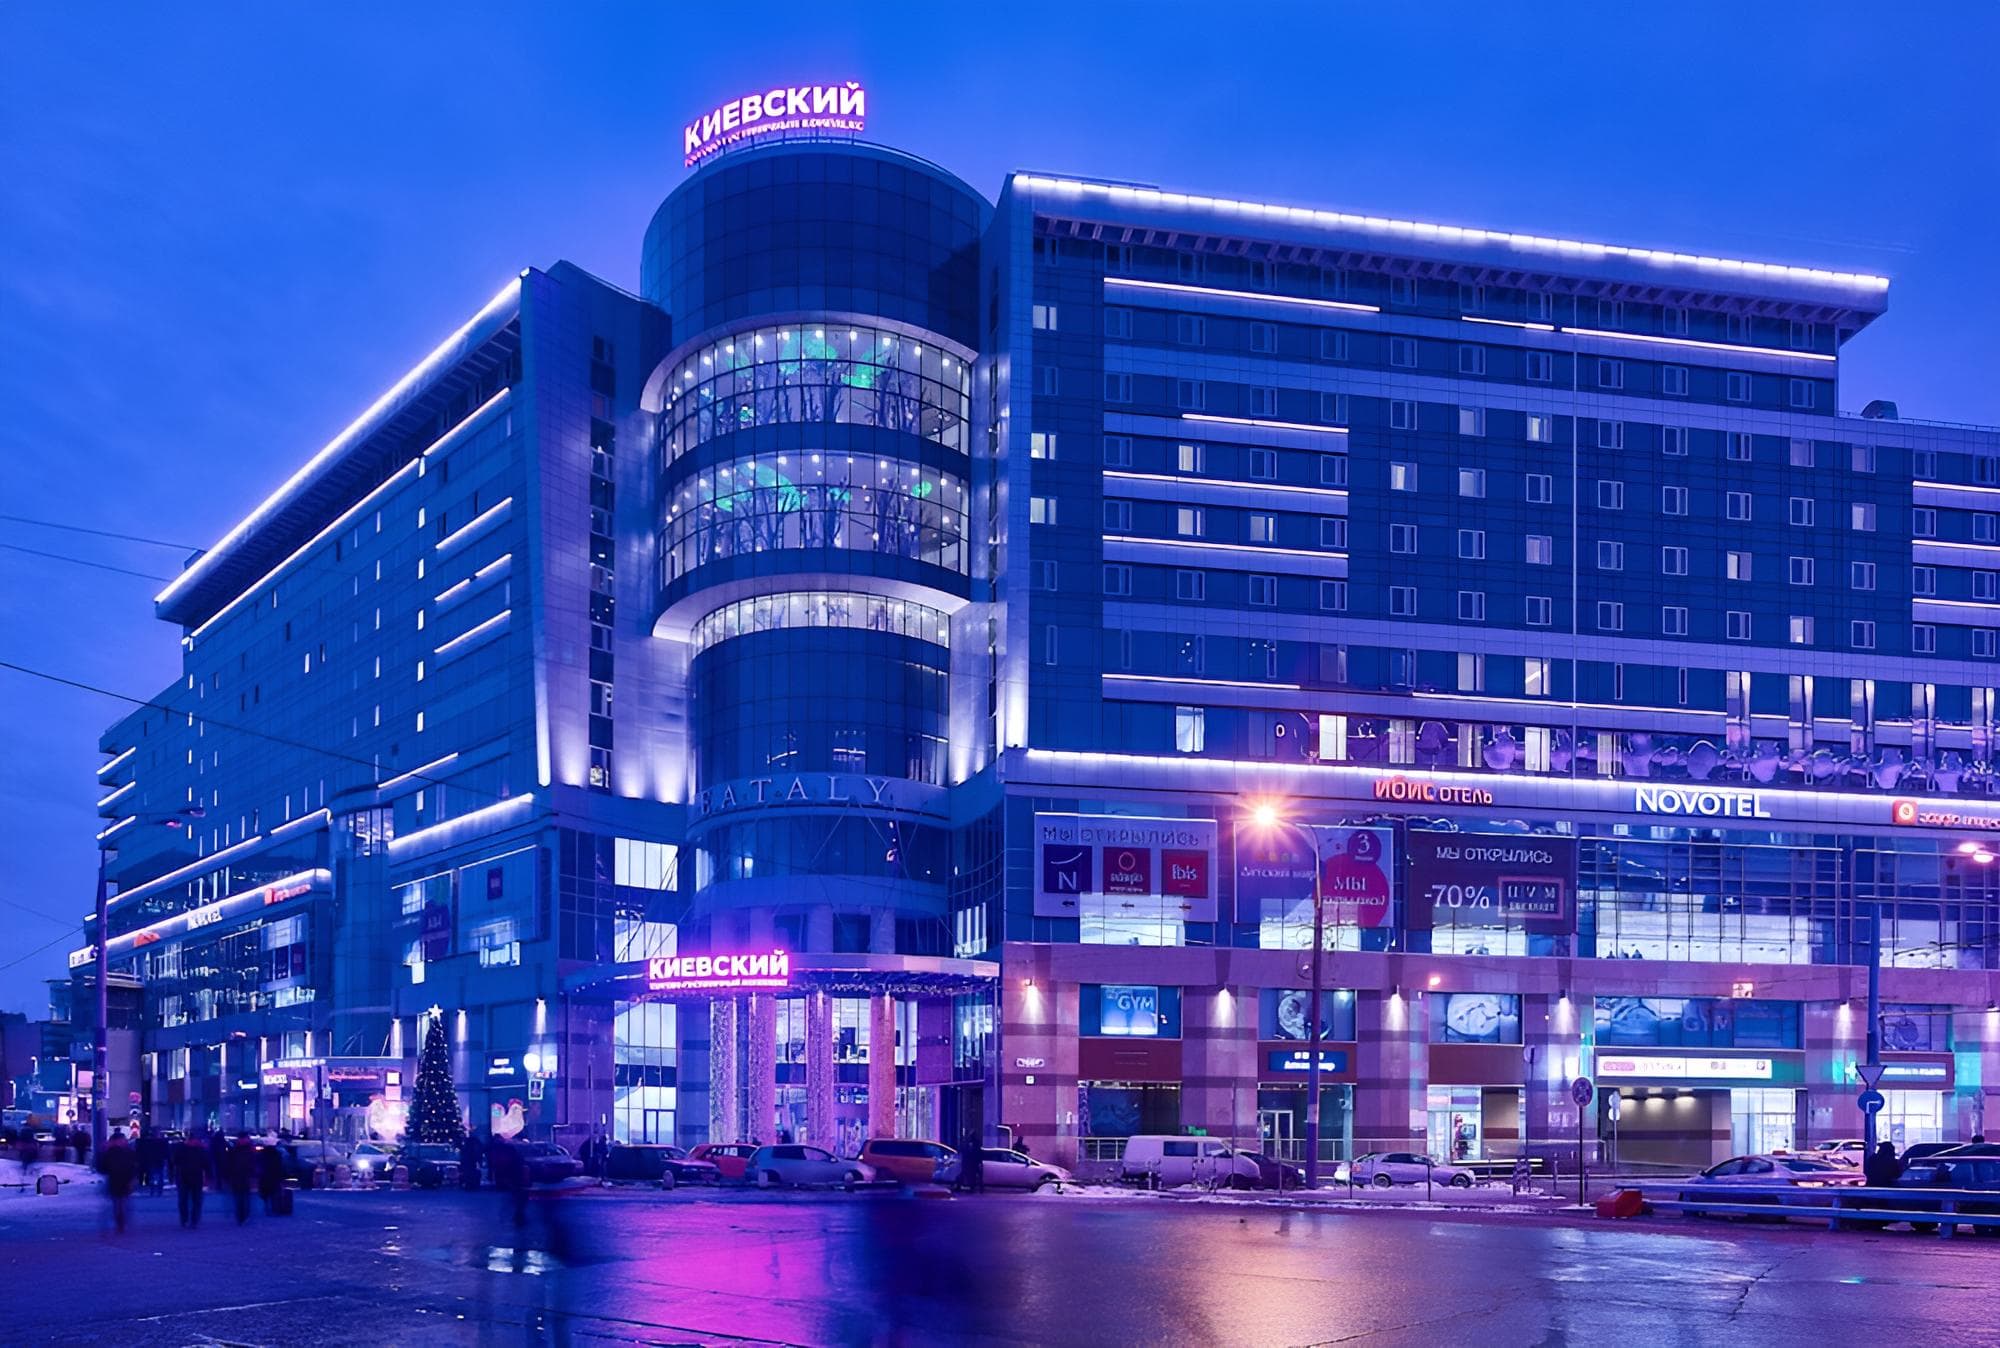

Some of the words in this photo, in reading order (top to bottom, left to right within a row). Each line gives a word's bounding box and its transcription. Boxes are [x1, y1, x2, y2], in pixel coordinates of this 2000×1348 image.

[684, 81, 865, 154] КИЕВСКИЙ
[700, 776, 889, 815] EATALY
[1635, 784, 1771, 817] NOVOTEL
[1436, 847, 1460, 859] МЫ
[1424, 884, 1490, 910] -70%
[649, 949, 789, 980] КИЕВСКИЙ
[1117, 995, 1154, 1010] GYM
